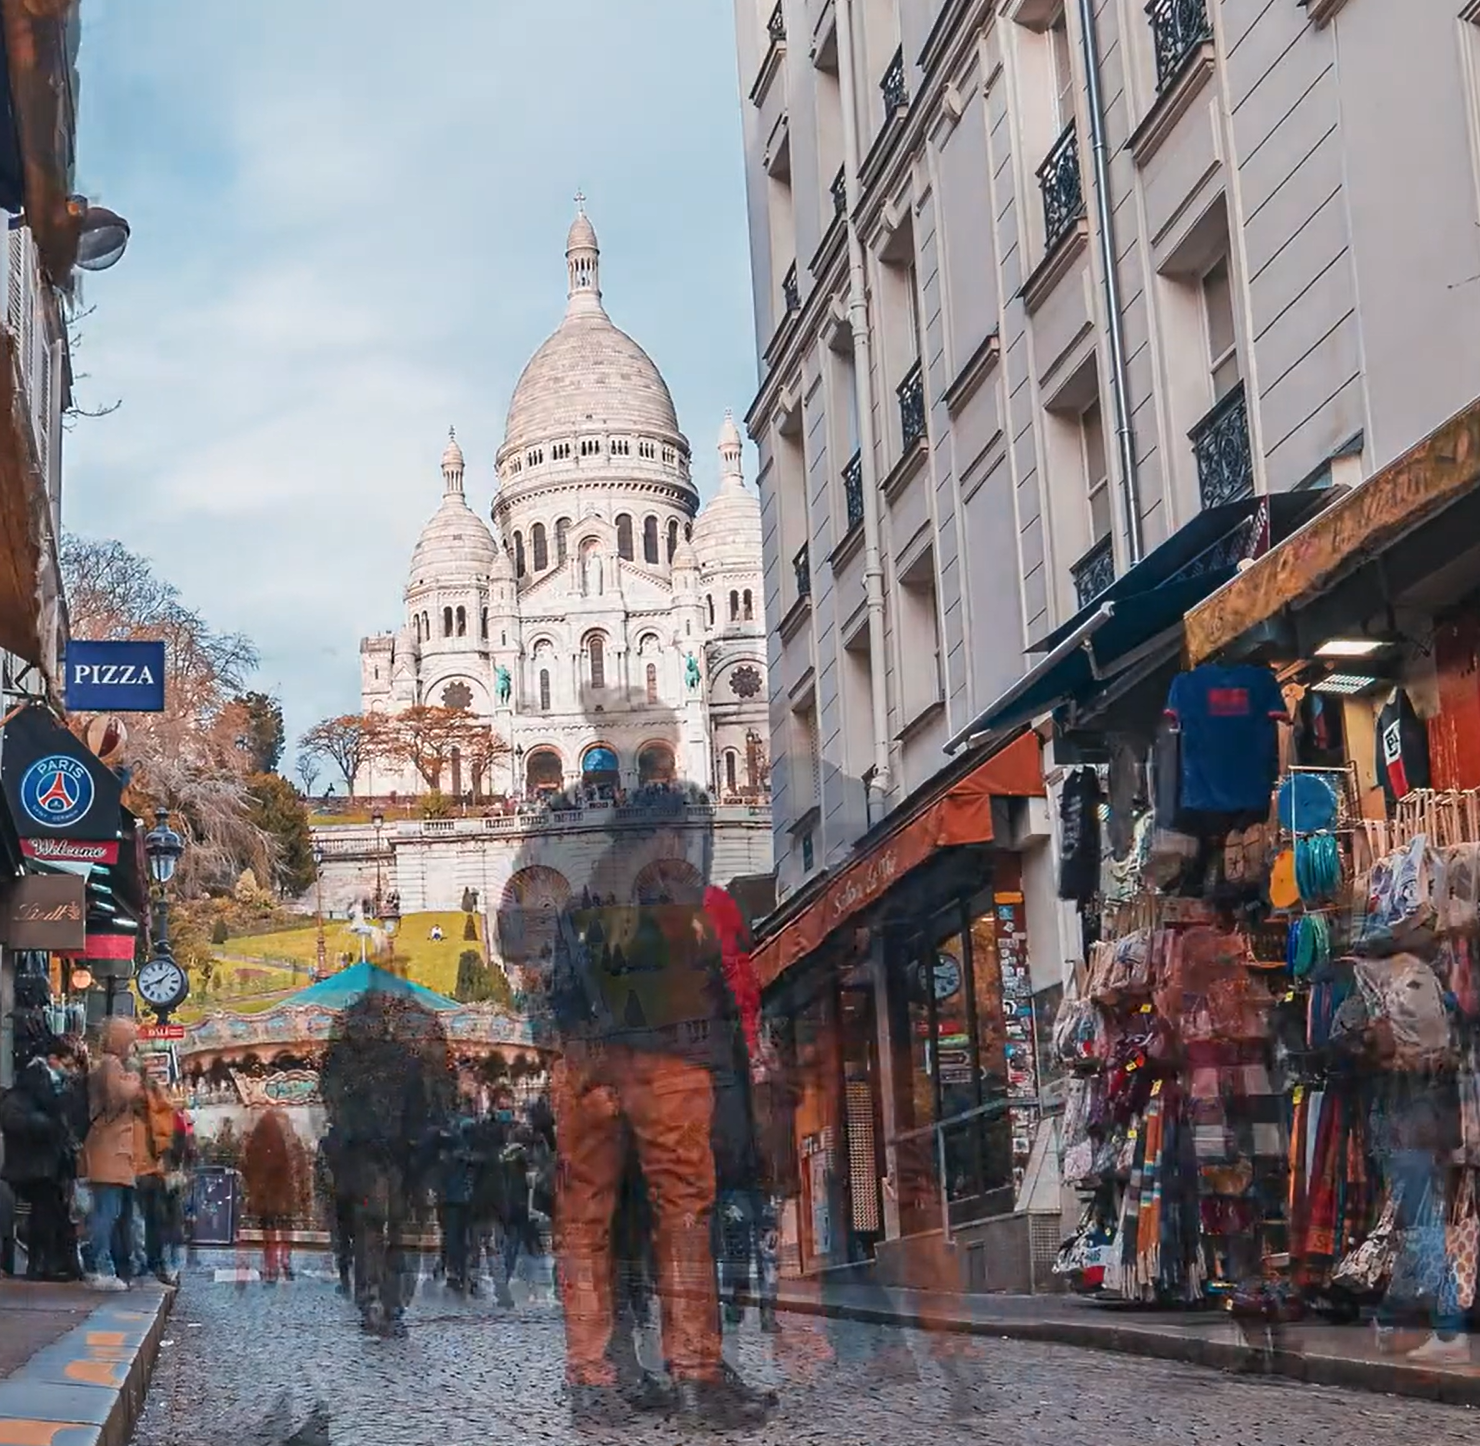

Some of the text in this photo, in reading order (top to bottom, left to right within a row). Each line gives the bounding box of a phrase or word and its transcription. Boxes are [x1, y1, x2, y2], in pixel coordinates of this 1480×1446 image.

[73, 664, 155, 685] PIZZA
[36, 759, 85, 779] PARIS
[28, 838, 107, 858] Welcome
